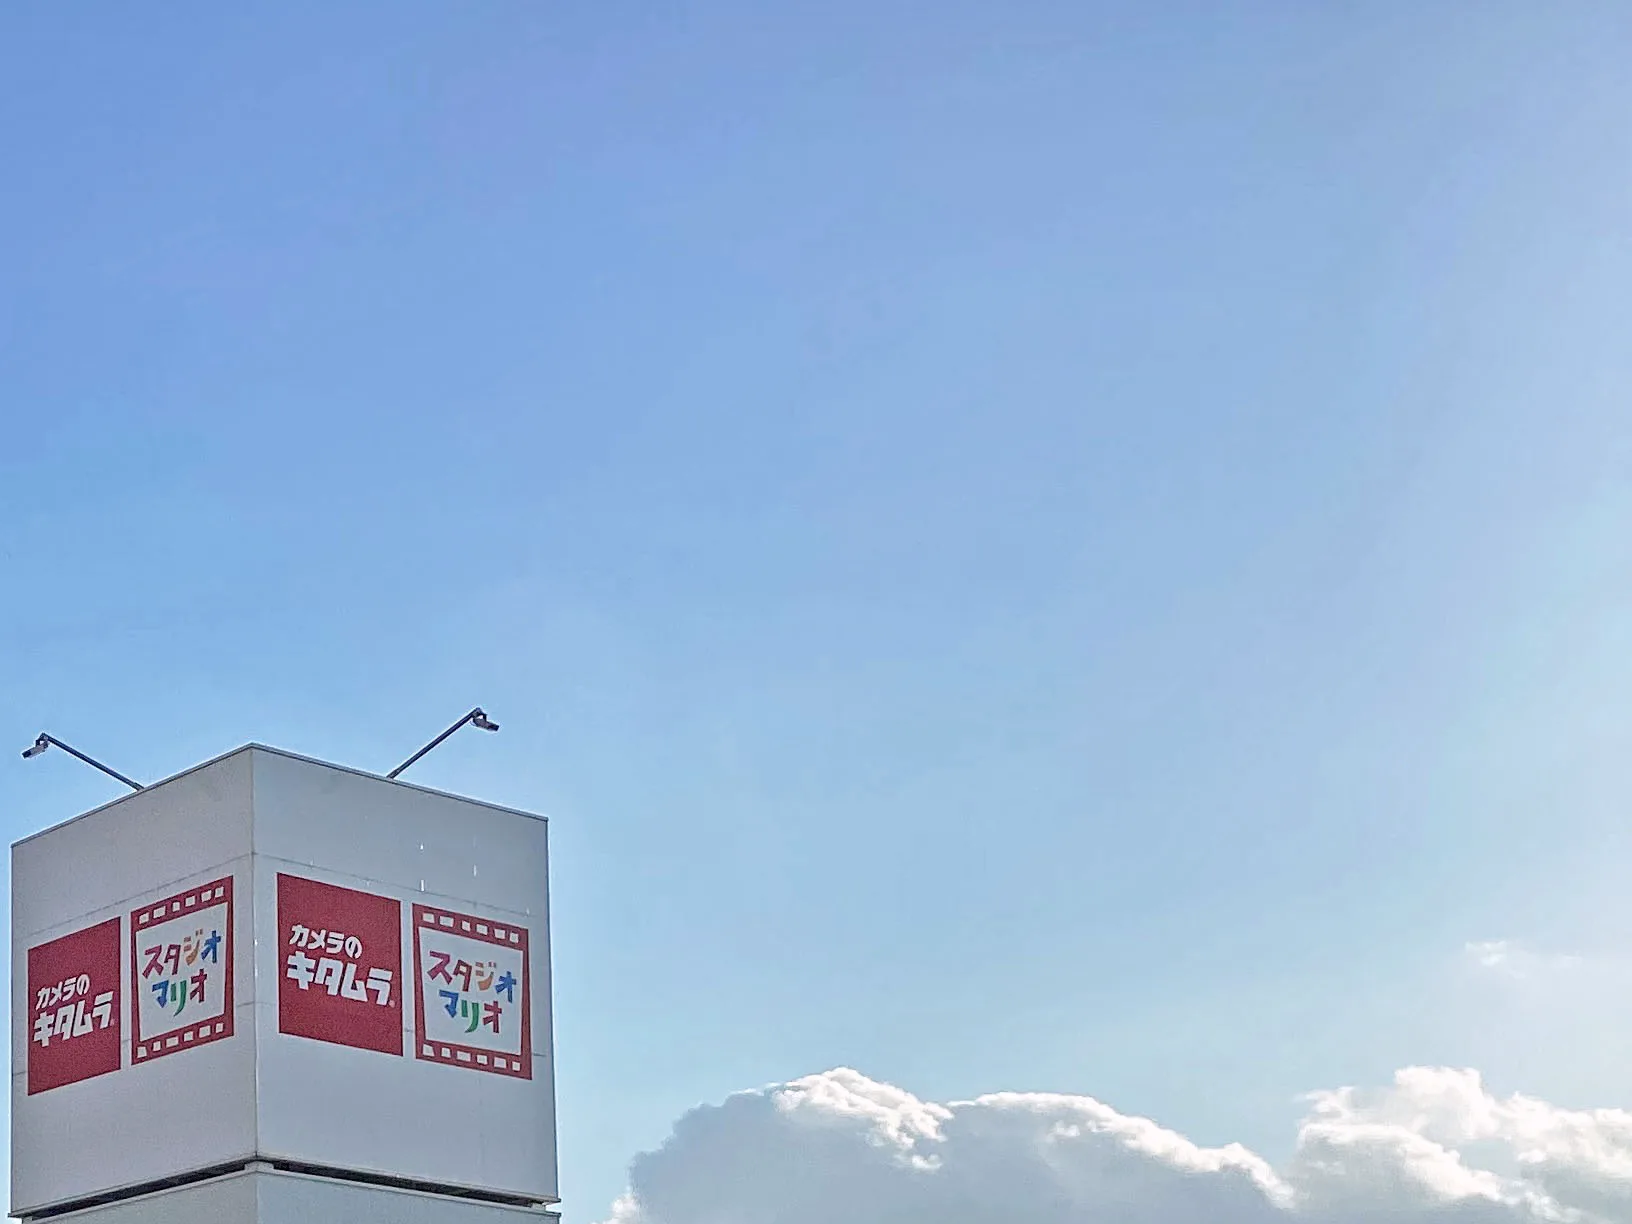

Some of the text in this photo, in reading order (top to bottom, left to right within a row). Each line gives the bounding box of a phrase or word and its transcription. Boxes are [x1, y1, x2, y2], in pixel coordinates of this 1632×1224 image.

[141, 929, 222, 979] スタジオ
[288, 923, 363, 960] カメラの
[35, 974, 90, 1010] カメラの
[151, 969, 208, 1017] マリオ
[286, 951, 394, 1007] キタムラ
[426, 950, 518, 1003] スタジオ
[32, 991, 114, 1048] キタムラ
[439, 989, 503, 1034] マリオ
